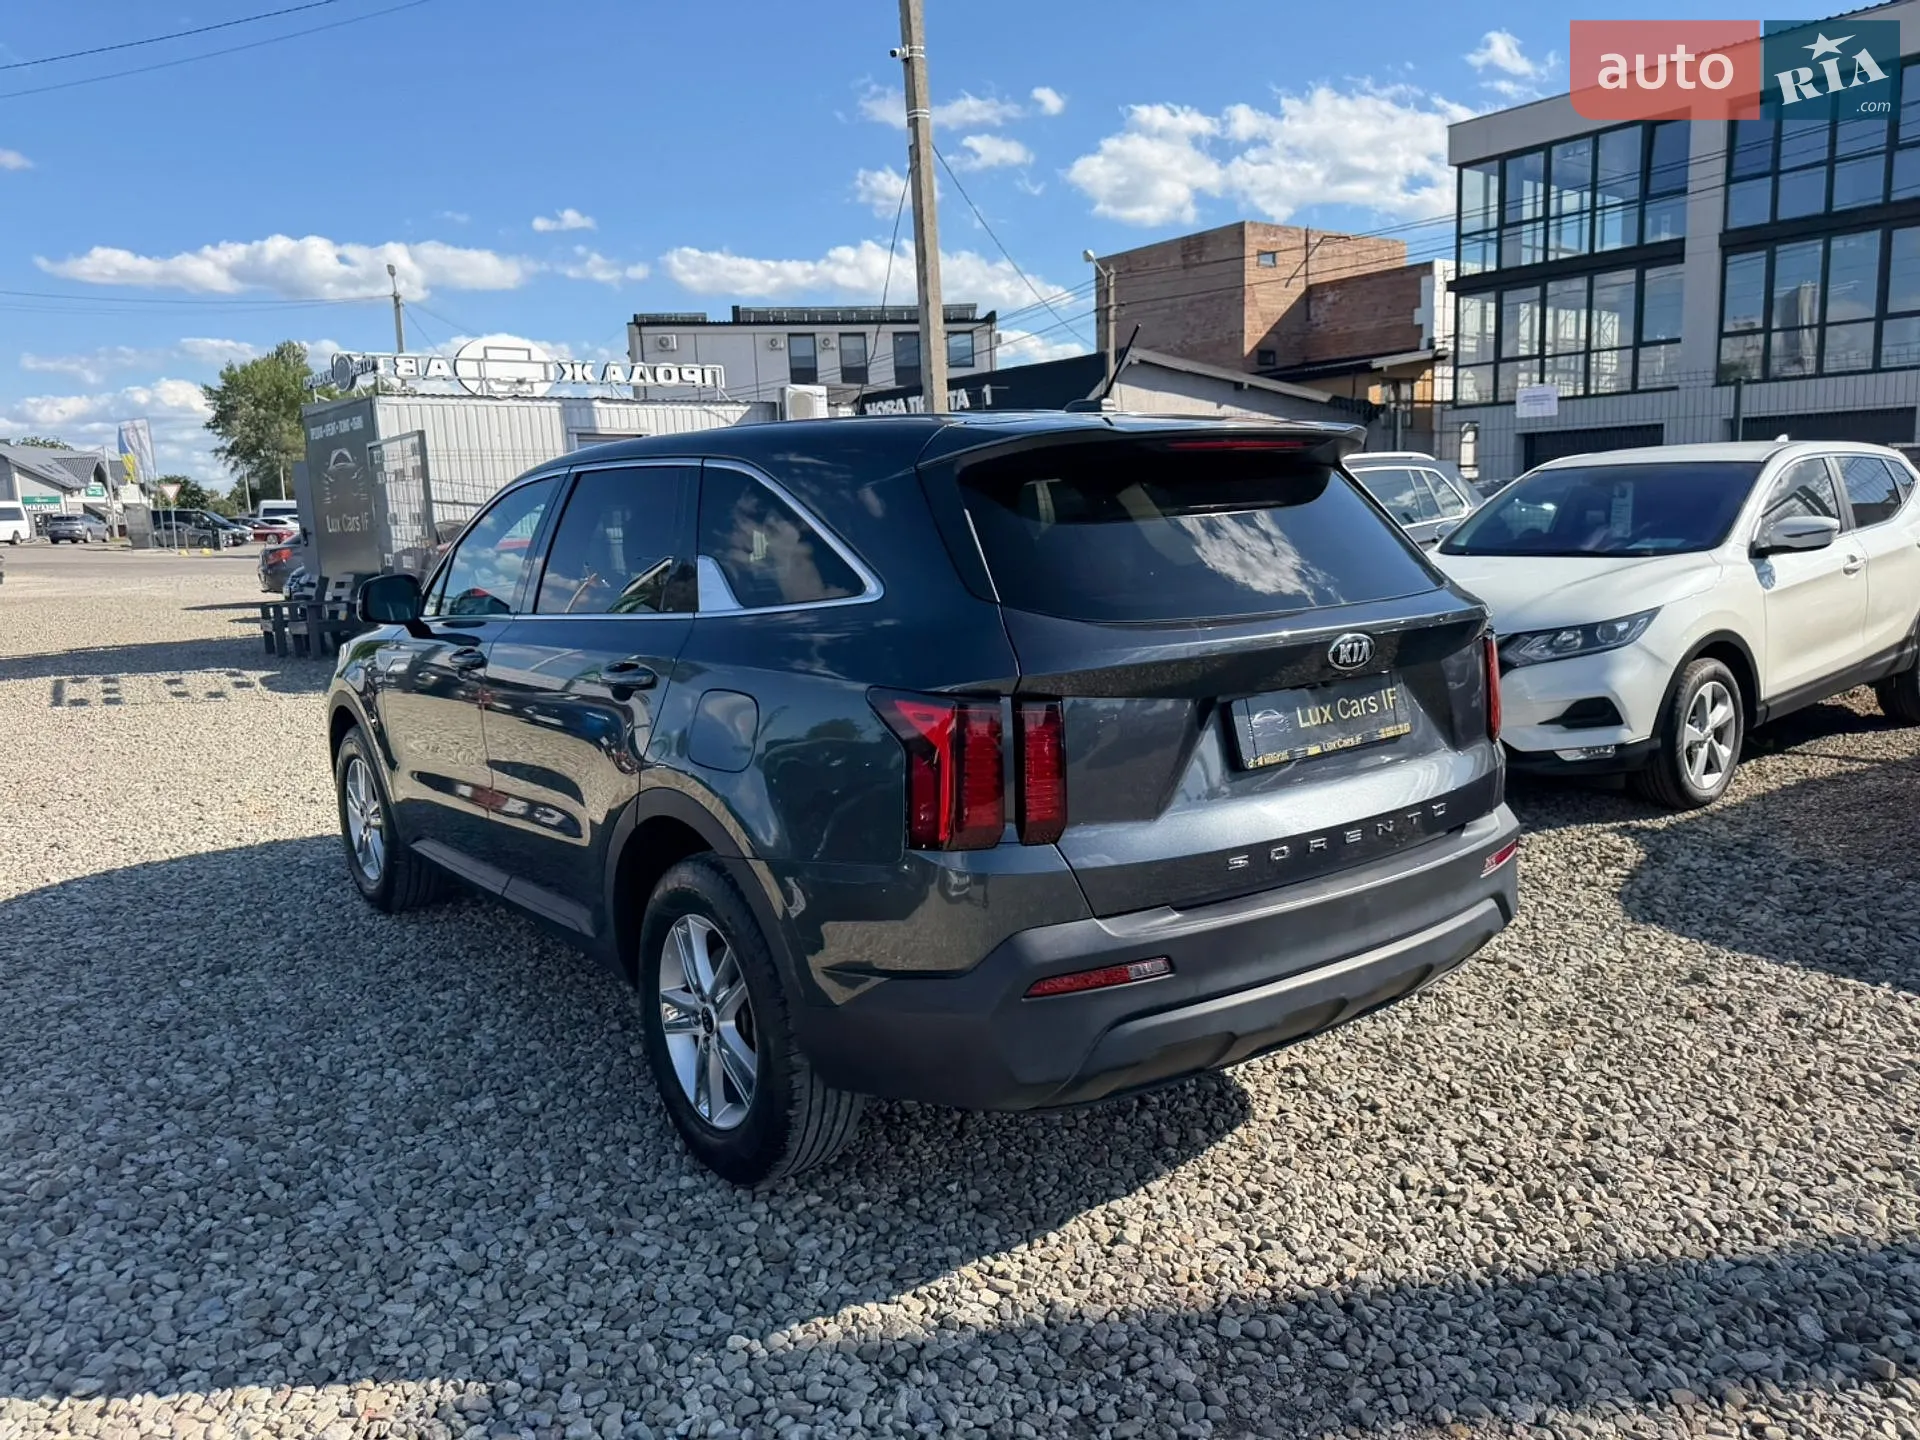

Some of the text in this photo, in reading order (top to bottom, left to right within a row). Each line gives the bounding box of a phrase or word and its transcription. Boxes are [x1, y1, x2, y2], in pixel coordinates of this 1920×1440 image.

[908, 388, 970, 415] ПТА
[1338, 639, 1371, 664] KIA
[1296, 688, 1397, 729] Lux Cars IF
[1227, 802, 1447, 871] SORENTO
